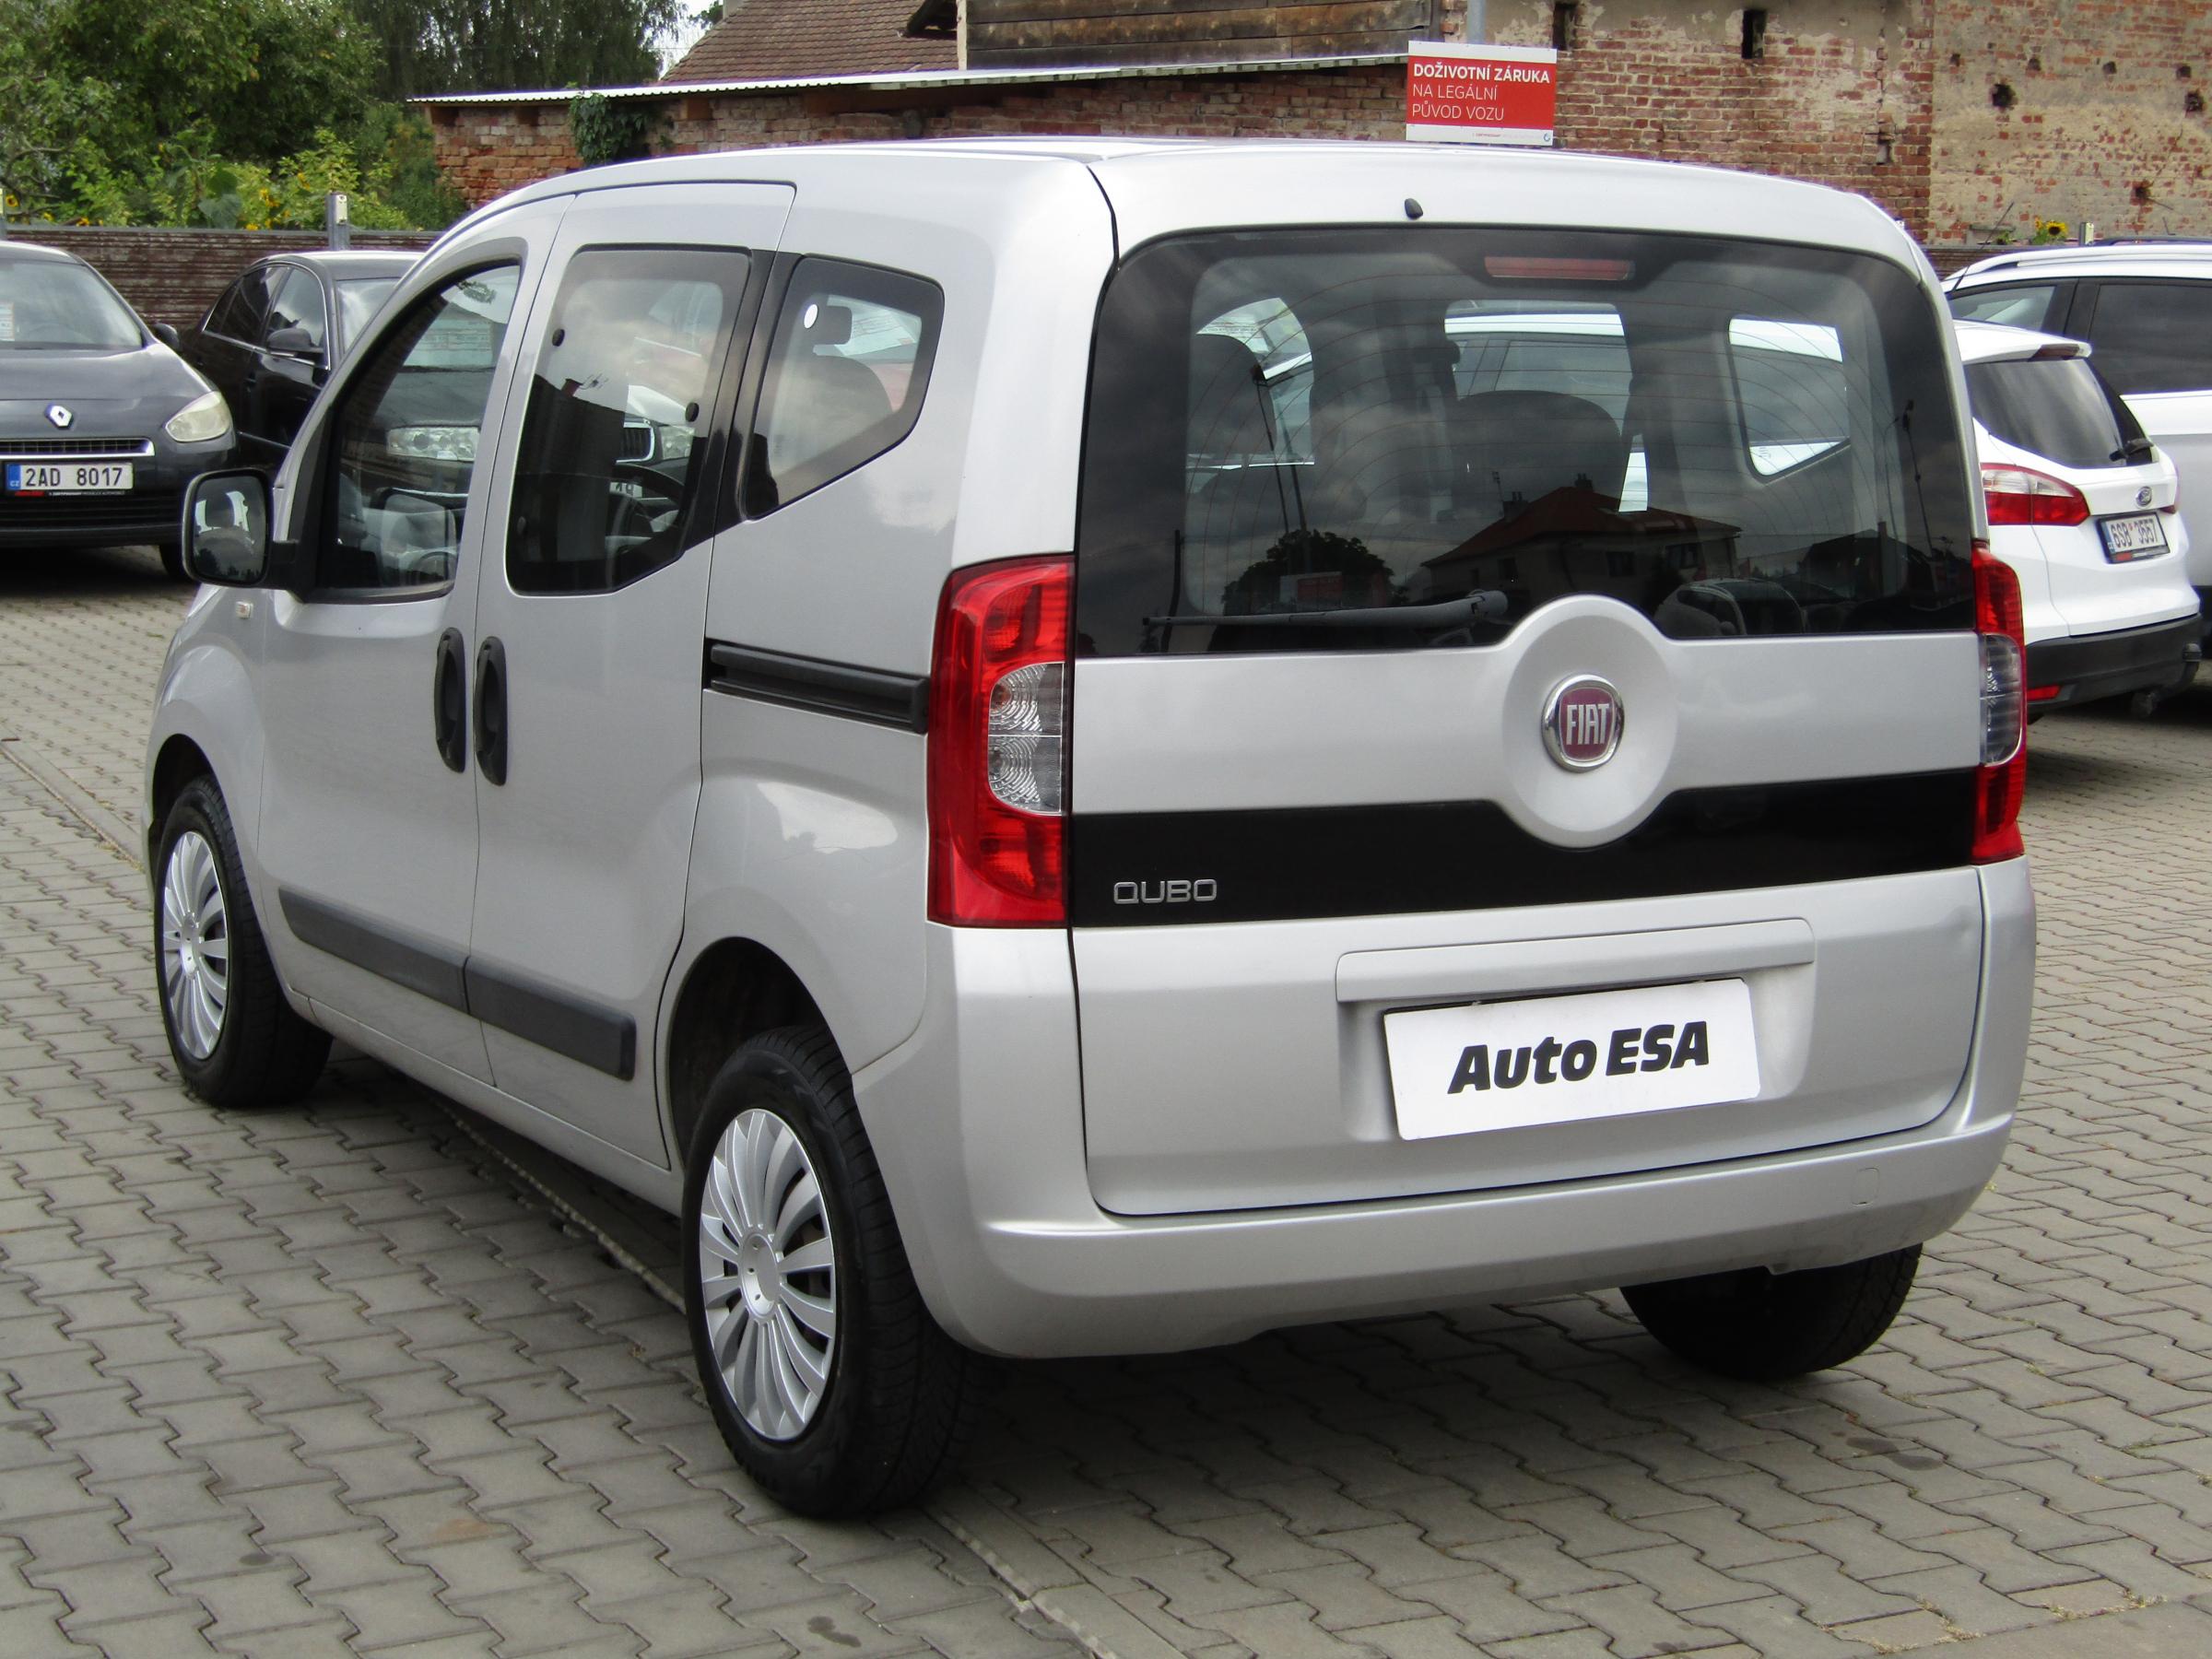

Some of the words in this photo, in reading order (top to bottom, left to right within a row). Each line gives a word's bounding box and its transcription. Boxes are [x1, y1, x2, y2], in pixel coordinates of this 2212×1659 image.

[1413, 62, 1490, 81] DOŽIVOTNÍ
[1494, 65, 1550, 84] ZÁRUKA
[1412, 84, 1433, 98] NA
[1438, 84, 1498, 100] LEGÁLNÍ
[1412, 100, 1462, 119] PŮVOD
[1466, 106, 1504, 121] VOZU
[26, 468, 61, 487] 2AD
[76, 467, 123, 487] 8017
[1566, 703, 1610, 746] FIAT
[1113, 878, 1218, 905] QUBO
[1447, 1036, 1597, 1095] Auto
[1605, 1020, 1710, 1077] ESA
